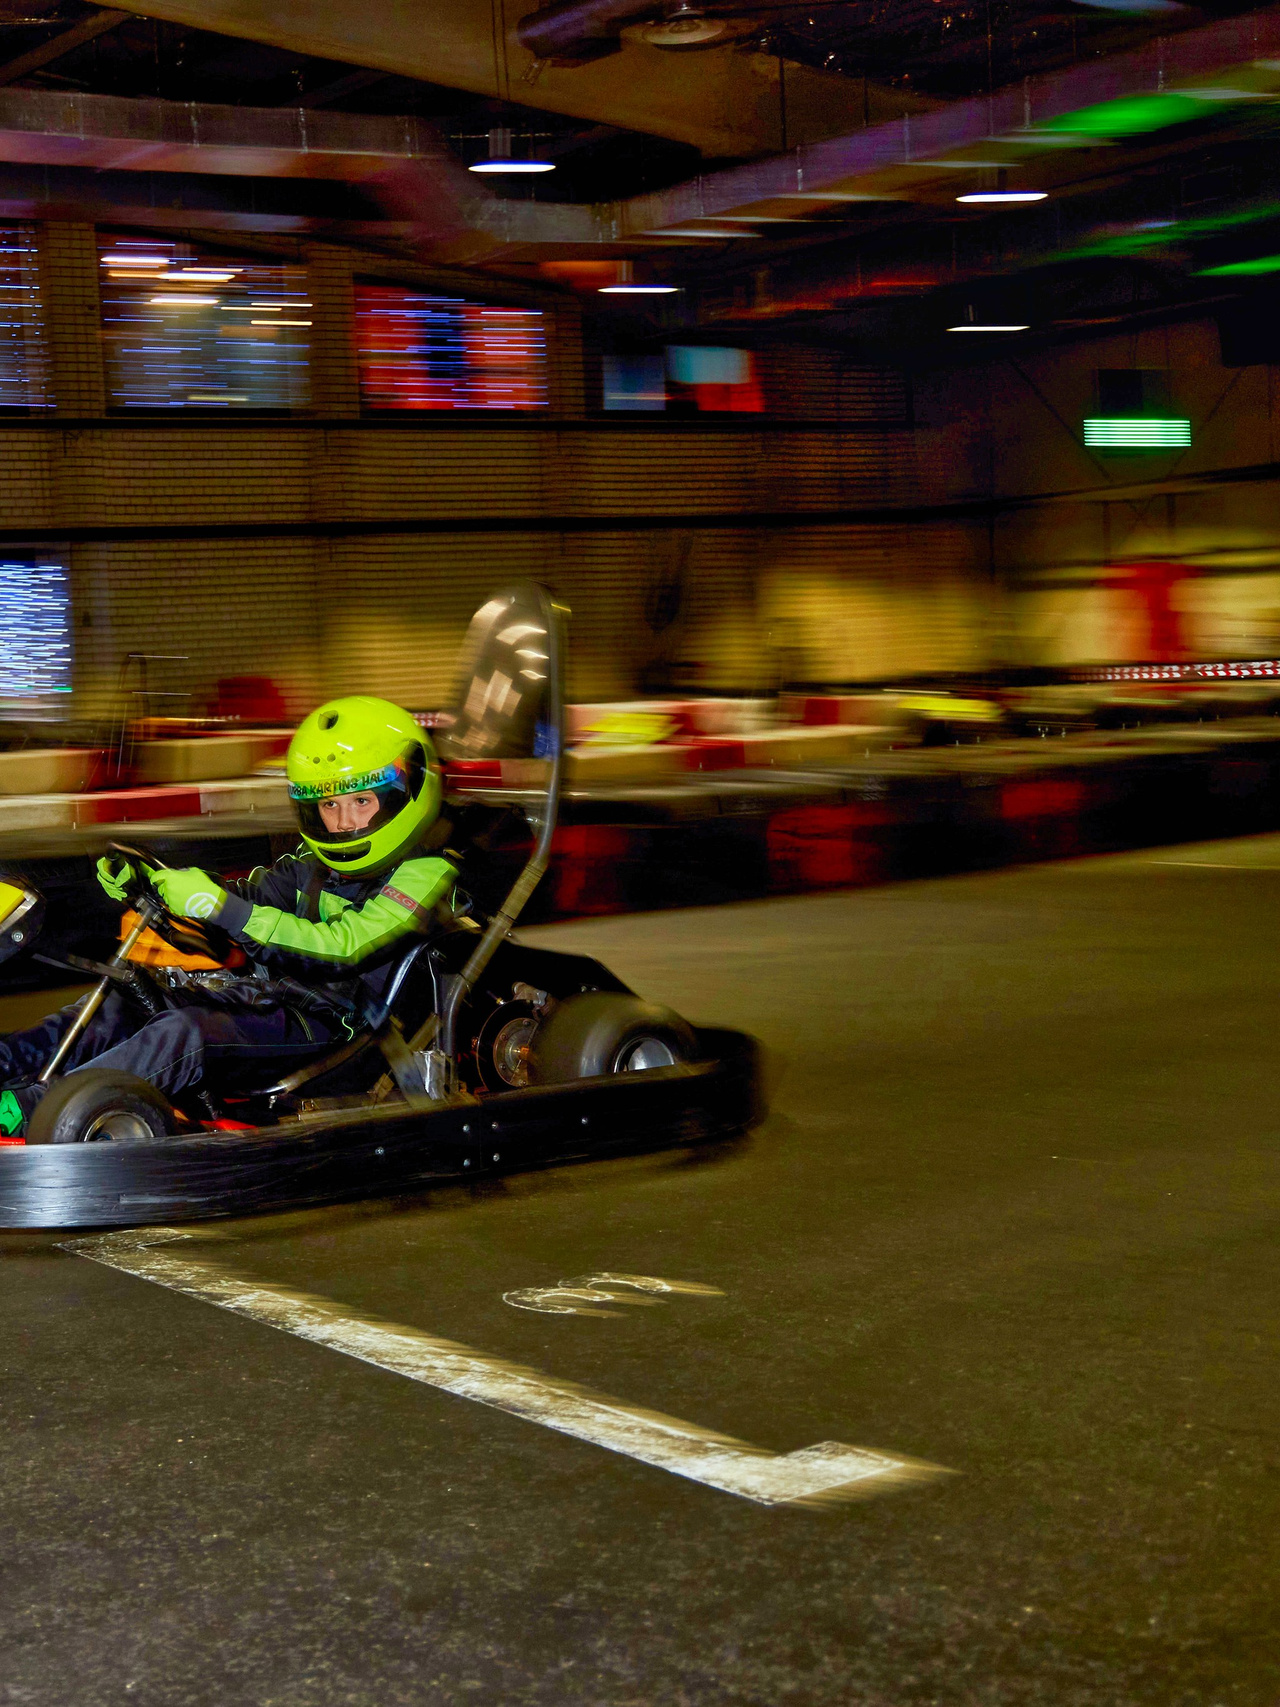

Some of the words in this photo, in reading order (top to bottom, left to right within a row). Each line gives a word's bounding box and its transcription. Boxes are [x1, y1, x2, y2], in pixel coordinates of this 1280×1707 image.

[309, 777, 358, 794] KARTING
[361, 770, 388, 787] HALL
[383, 887, 415, 909] RLG
